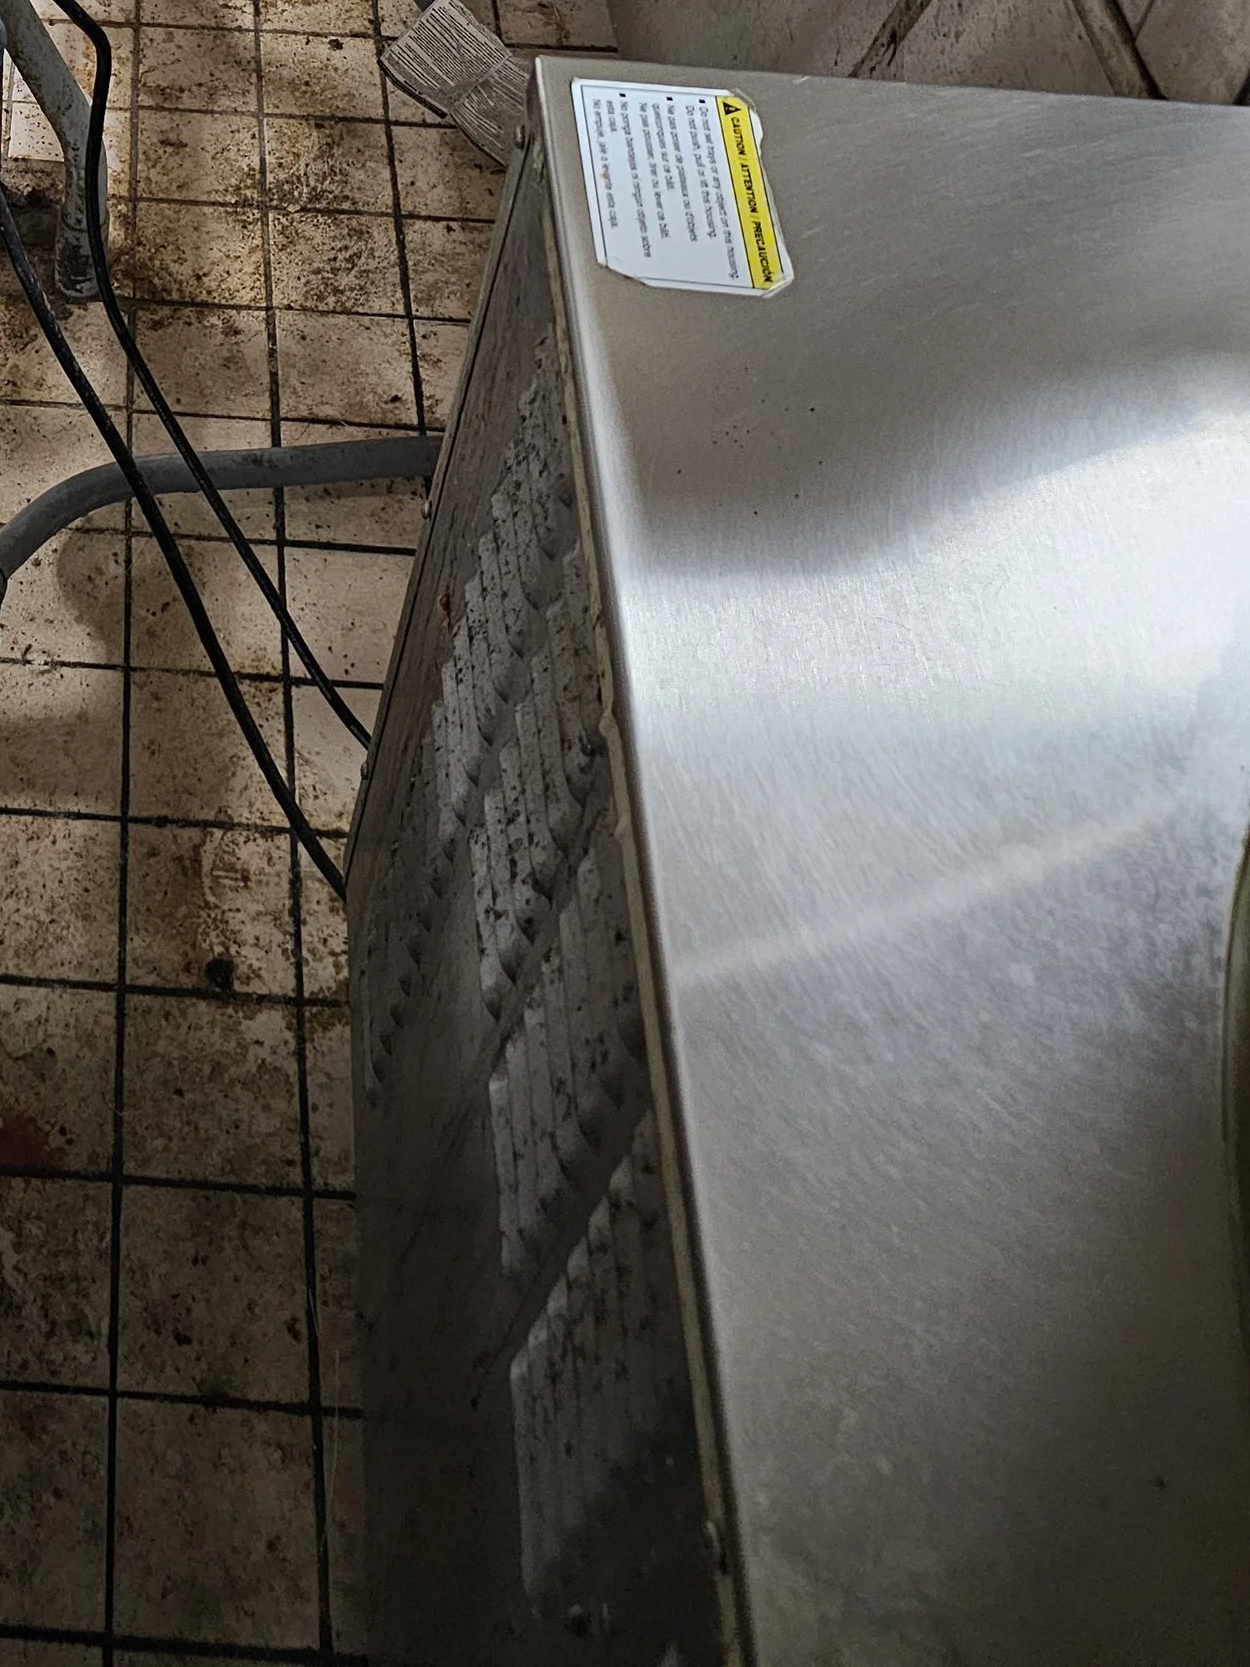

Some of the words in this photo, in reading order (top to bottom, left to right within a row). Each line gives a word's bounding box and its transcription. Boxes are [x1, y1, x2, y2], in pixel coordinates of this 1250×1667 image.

[731, 117, 746, 155] CAUTION
[740, 163, 758, 213] ATTENTION
[752, 221, 774, 283] PRECAUCIÓN
